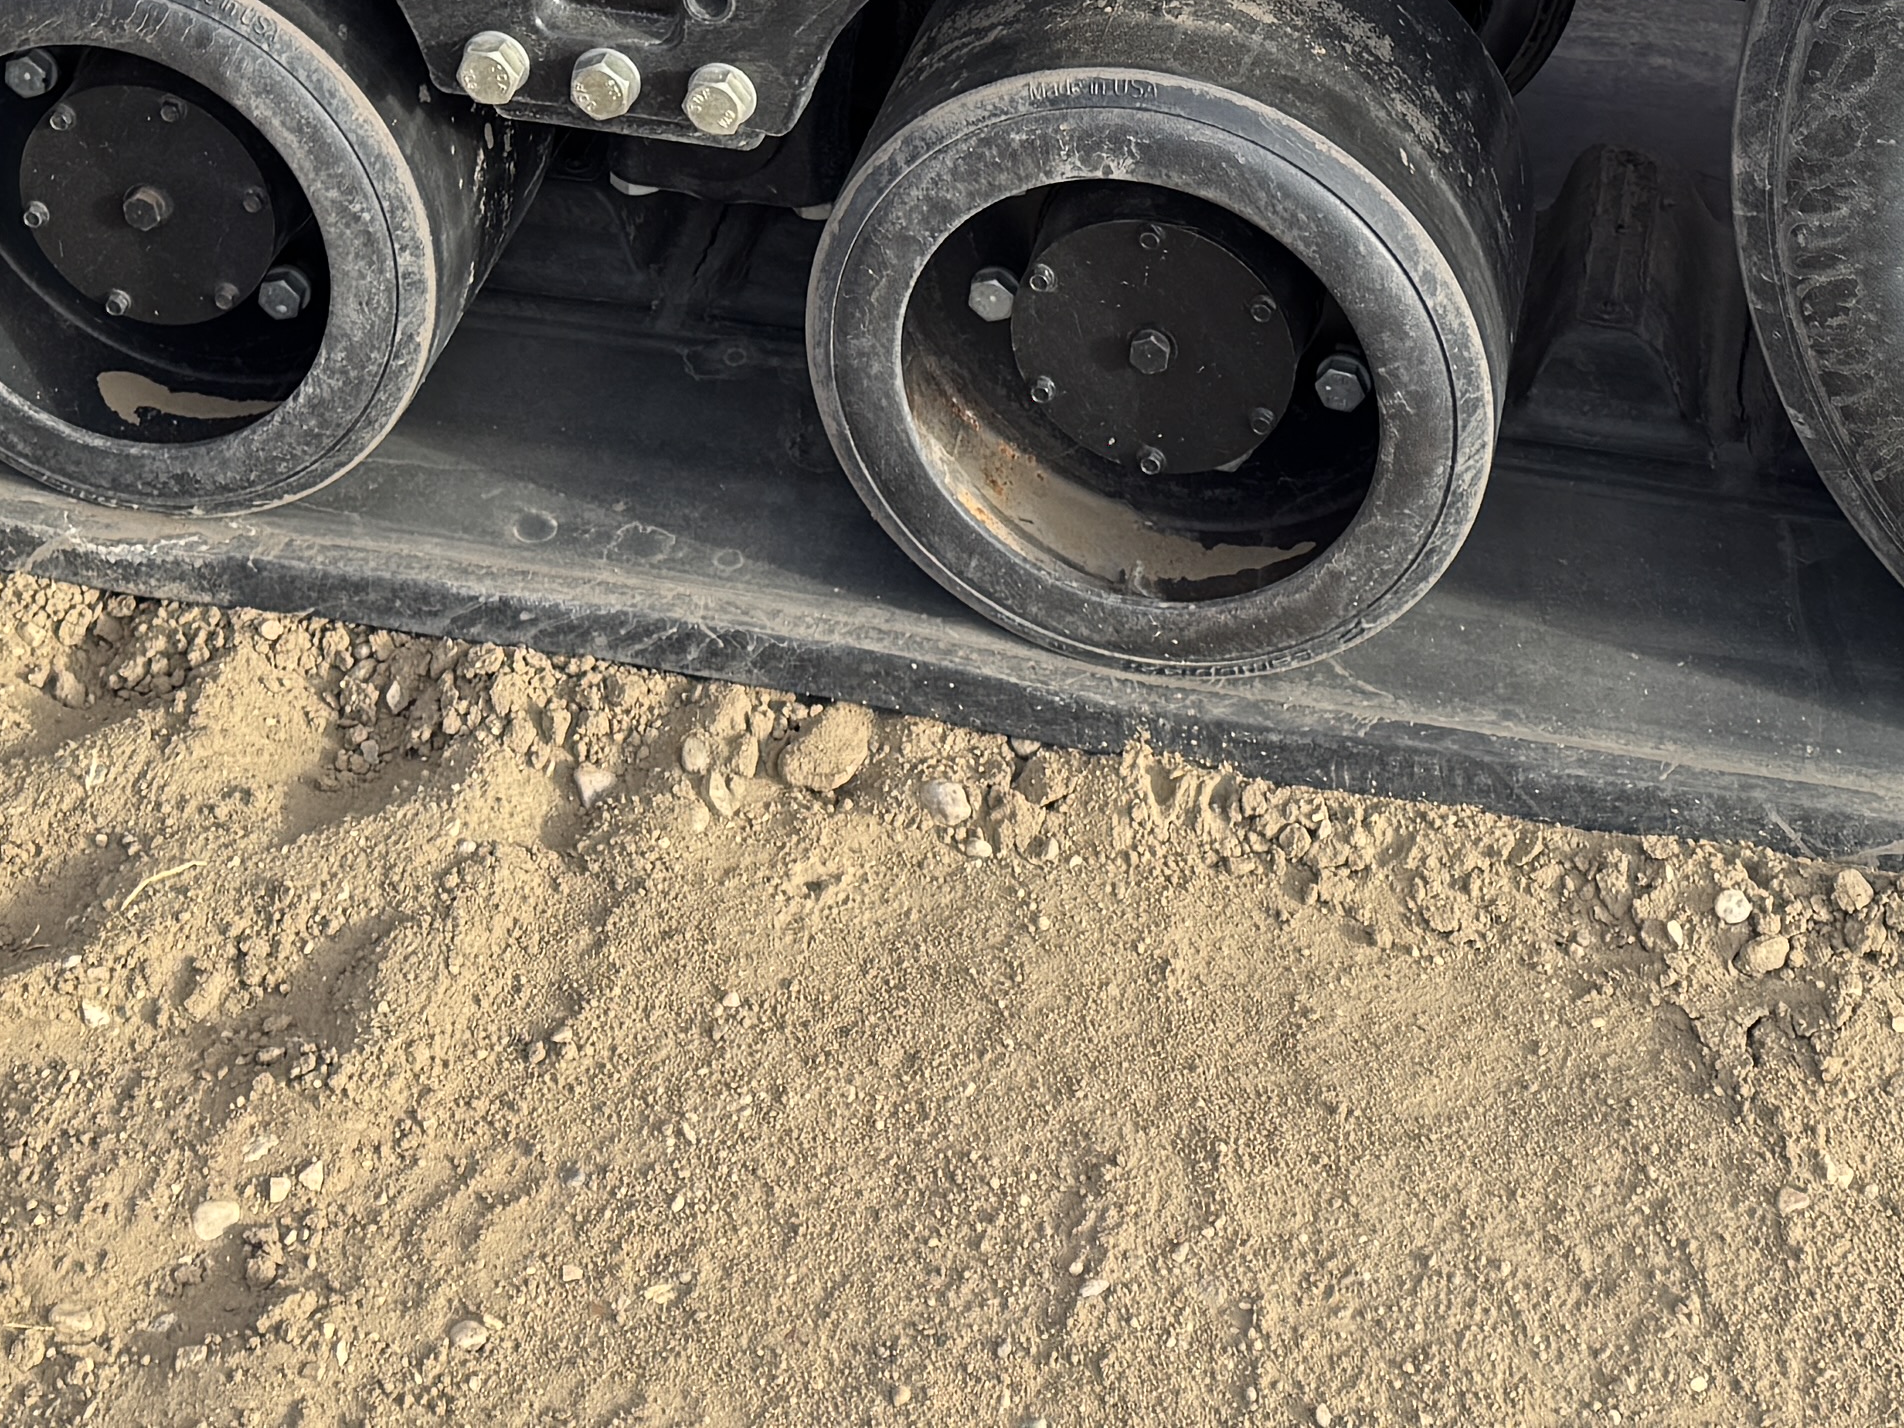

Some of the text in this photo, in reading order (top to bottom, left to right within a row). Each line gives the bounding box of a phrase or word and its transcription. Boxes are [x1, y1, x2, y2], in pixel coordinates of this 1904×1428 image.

[1027, 76, 1159, 101] Made in USA
